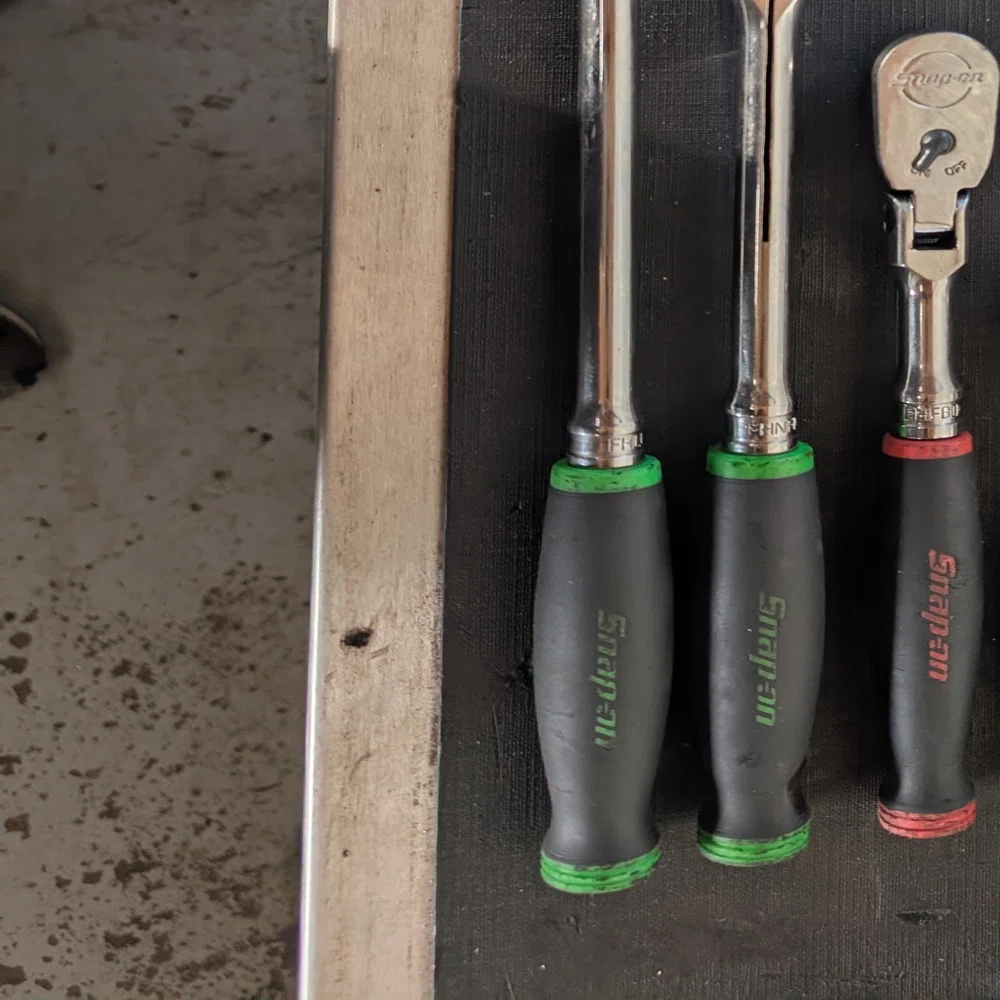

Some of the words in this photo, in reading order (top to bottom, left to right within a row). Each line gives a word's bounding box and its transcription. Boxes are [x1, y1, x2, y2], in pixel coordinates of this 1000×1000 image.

[891, 71, 985, 89] Snap-on
[944, 160, 968, 177] OFF
[588, 608, 628, 751] Snap-on
[751, 592, 787, 726] Snap-on
[920, 549, 958, 683] Snap-on
